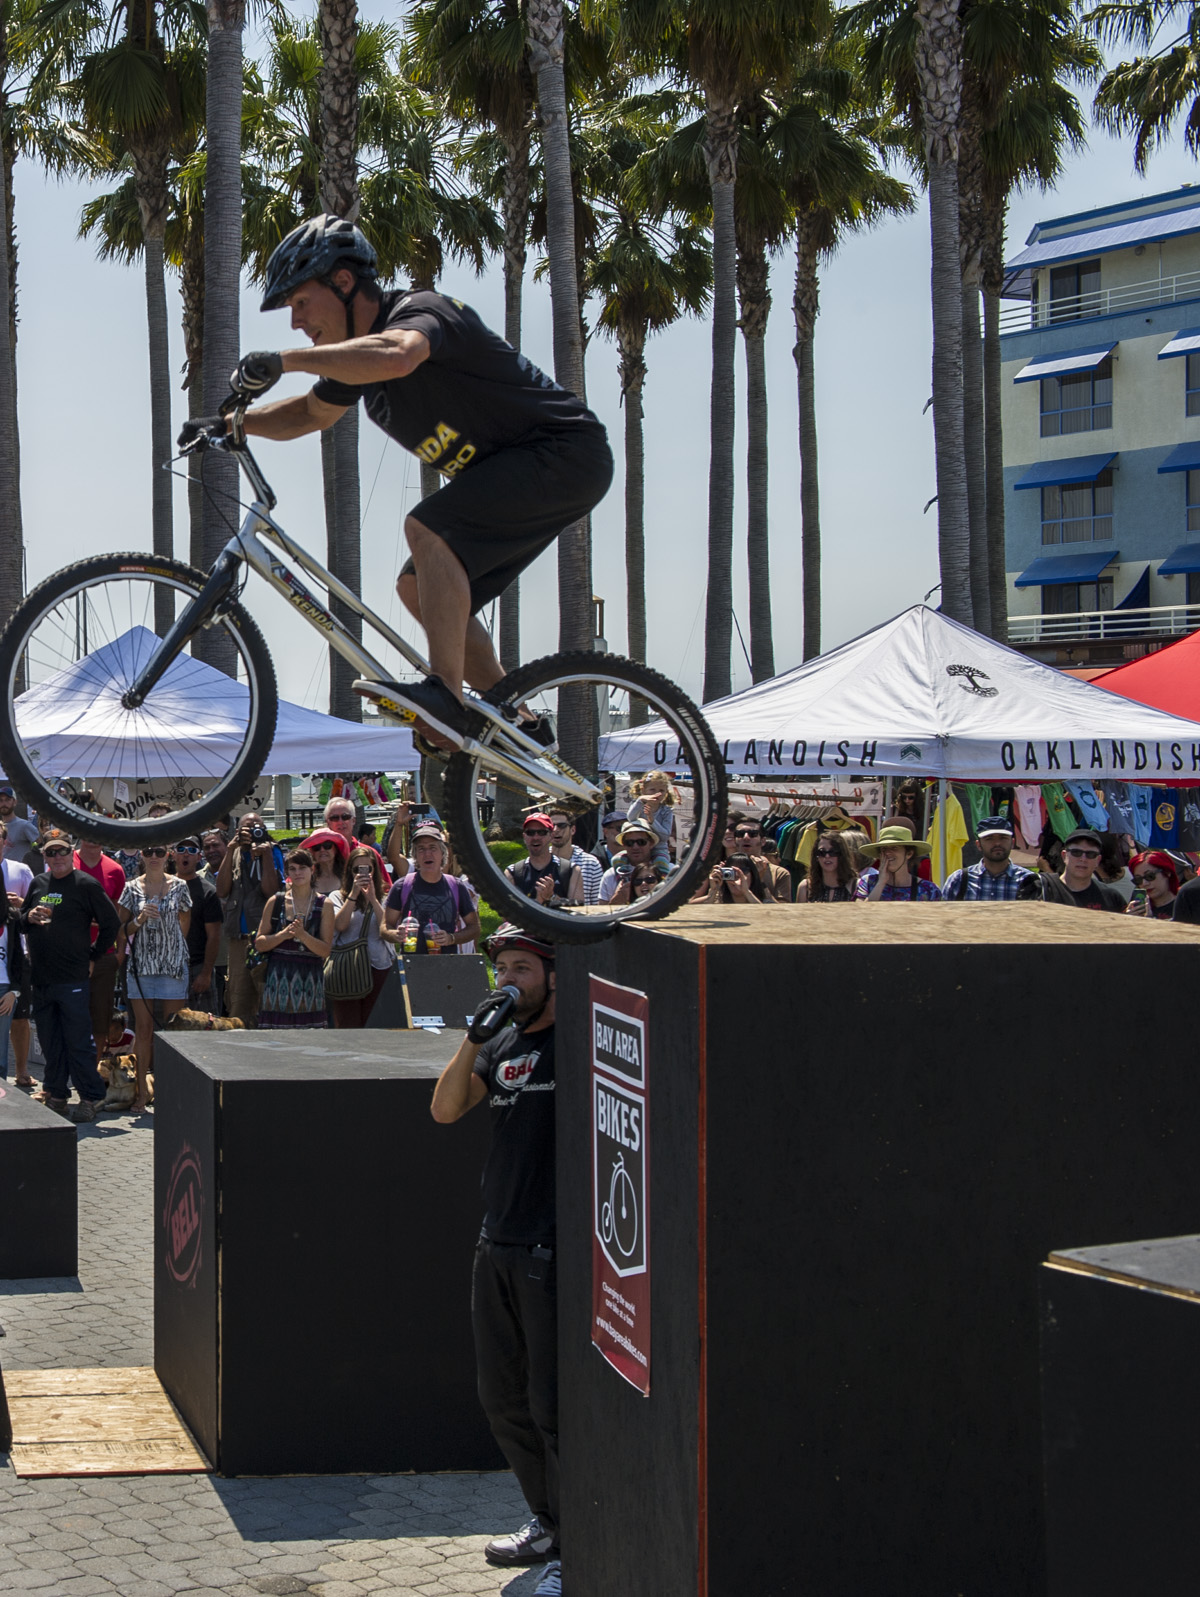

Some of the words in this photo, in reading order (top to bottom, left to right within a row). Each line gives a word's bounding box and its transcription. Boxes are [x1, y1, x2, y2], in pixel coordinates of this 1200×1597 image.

[290, 594, 334, 631] KENDA
[654, 739, 878, 767] OALANDISH
[686, 715, 712, 758] NEVEGAL
[541, 750, 585, 785] KENDA
[1001, 740, 1200, 771] OAKLANDISH
[48, 796, 98, 826] KENDA
[596, 1021, 614, 1054] BAY
[615, 1030, 640, 1066] AREA
[597, 1088, 640, 1152] BIKES
[170, 1181, 199, 1261] BELL
